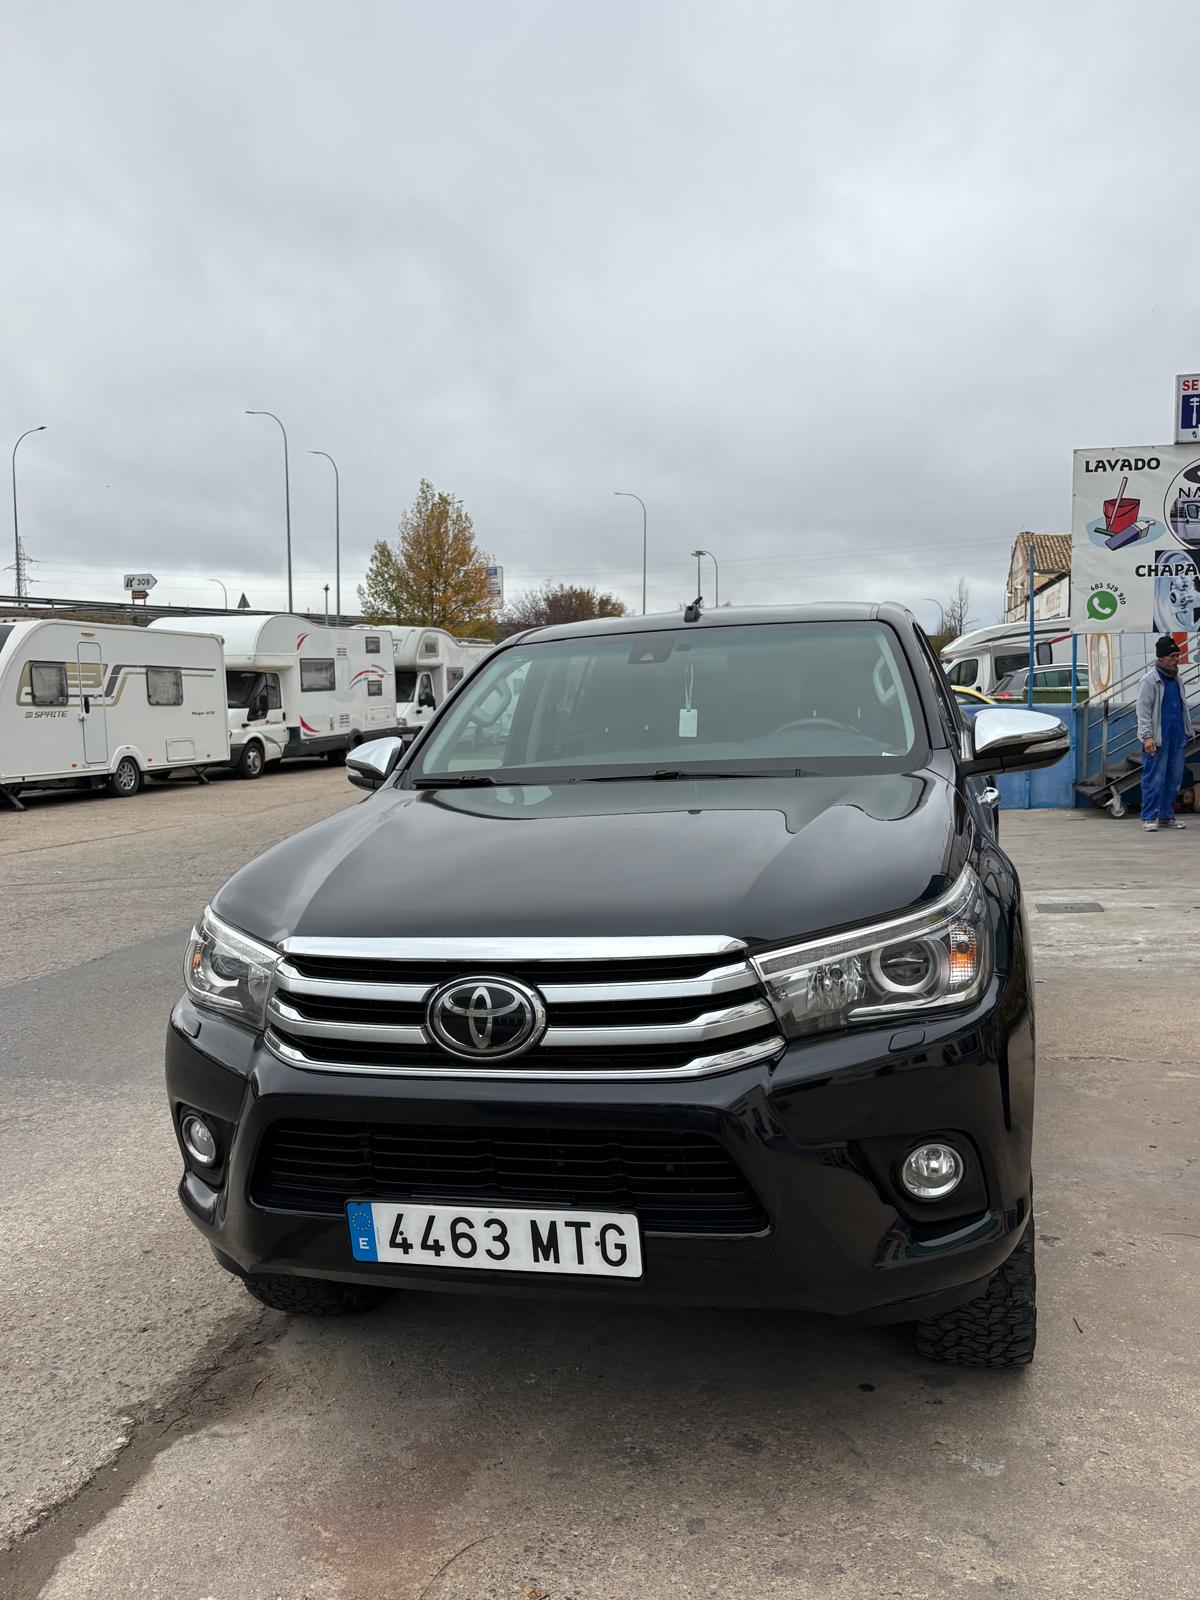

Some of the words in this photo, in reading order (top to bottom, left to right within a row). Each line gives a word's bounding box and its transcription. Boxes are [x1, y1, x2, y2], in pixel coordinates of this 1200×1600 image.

[1085, 457, 1160, 473] LAVADO
[1135, 563, 1198, 577] CHAPA
[137, 578, 150, 586] 309
[1090, 582, 1104, 592] 683
[34, 711, 69, 719] SPRITE
[359, 1237, 370, 1250] E
[389, 1213, 510, 1260] 4463
[530, 1219, 627, 1267] MTG
